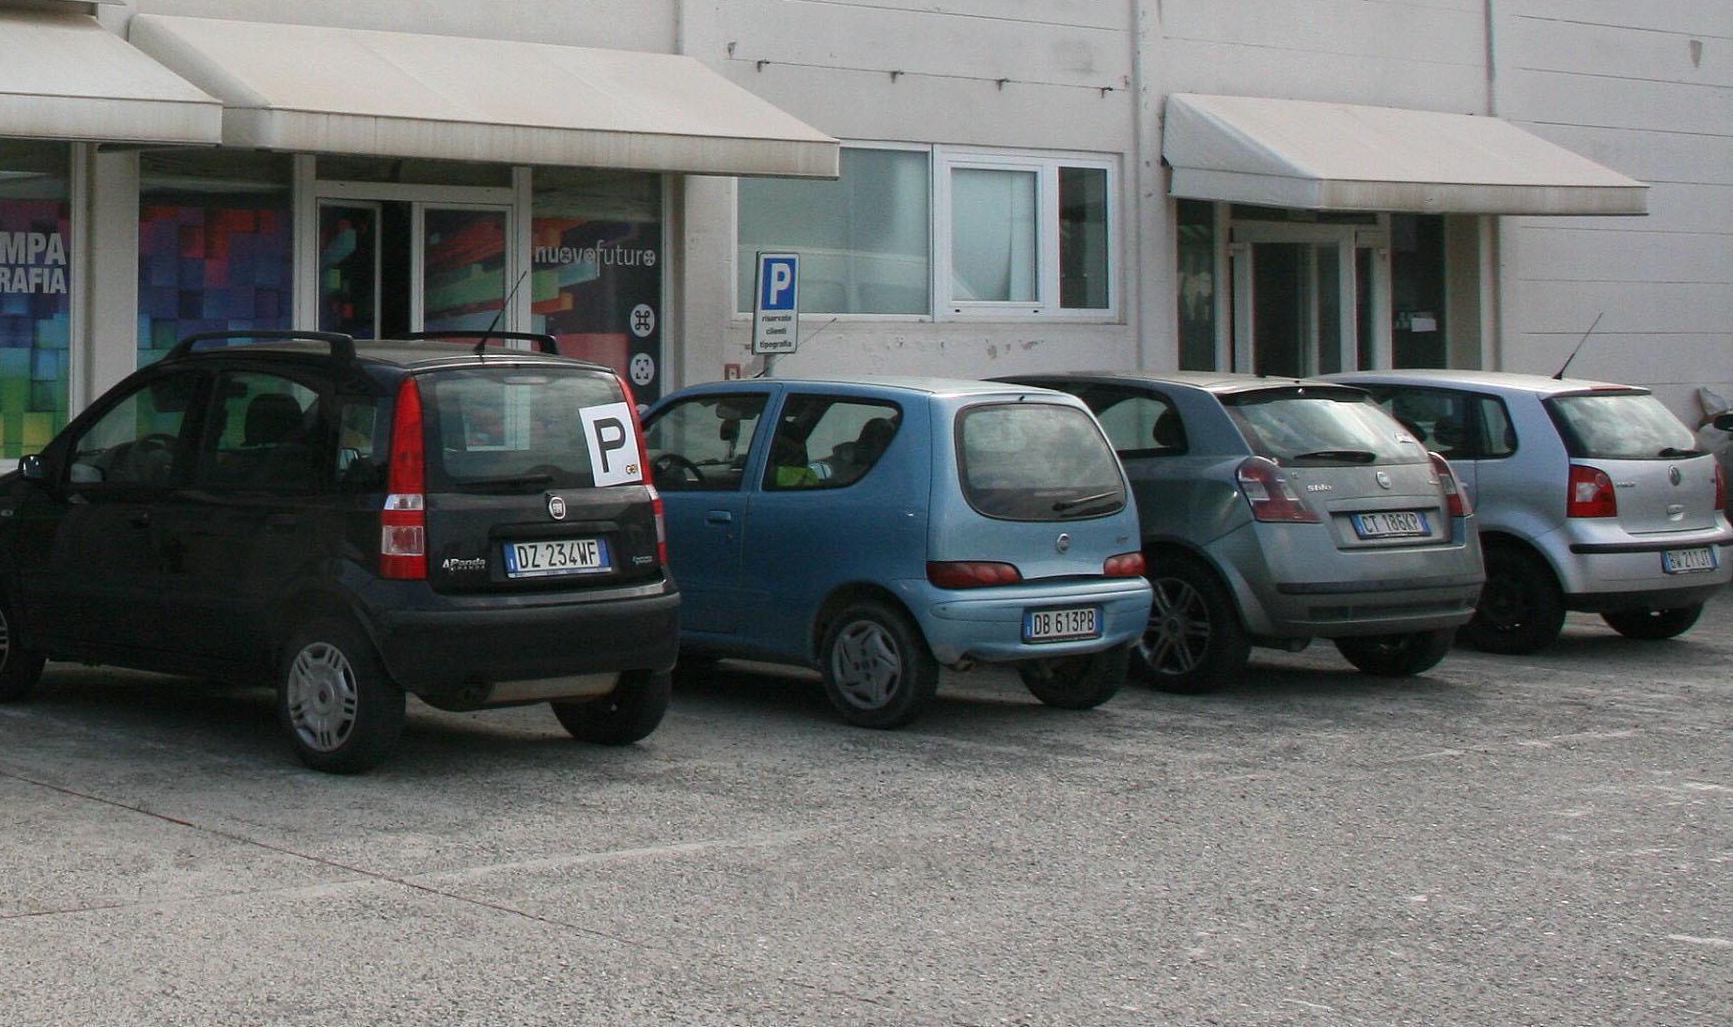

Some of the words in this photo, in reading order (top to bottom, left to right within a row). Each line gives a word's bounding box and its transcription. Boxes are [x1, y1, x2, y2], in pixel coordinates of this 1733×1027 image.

[769, 263, 791, 305] P
[759, 339, 792, 351] tipografia
[593, 417, 627, 474] P
[1361, 515, 1379, 533] CT
[517, 544, 542, 570] DZ
[545, 540, 597, 567] 234WF
[1033, 613, 1051, 636] DB
[1055, 609, 1095, 634] 613PB
